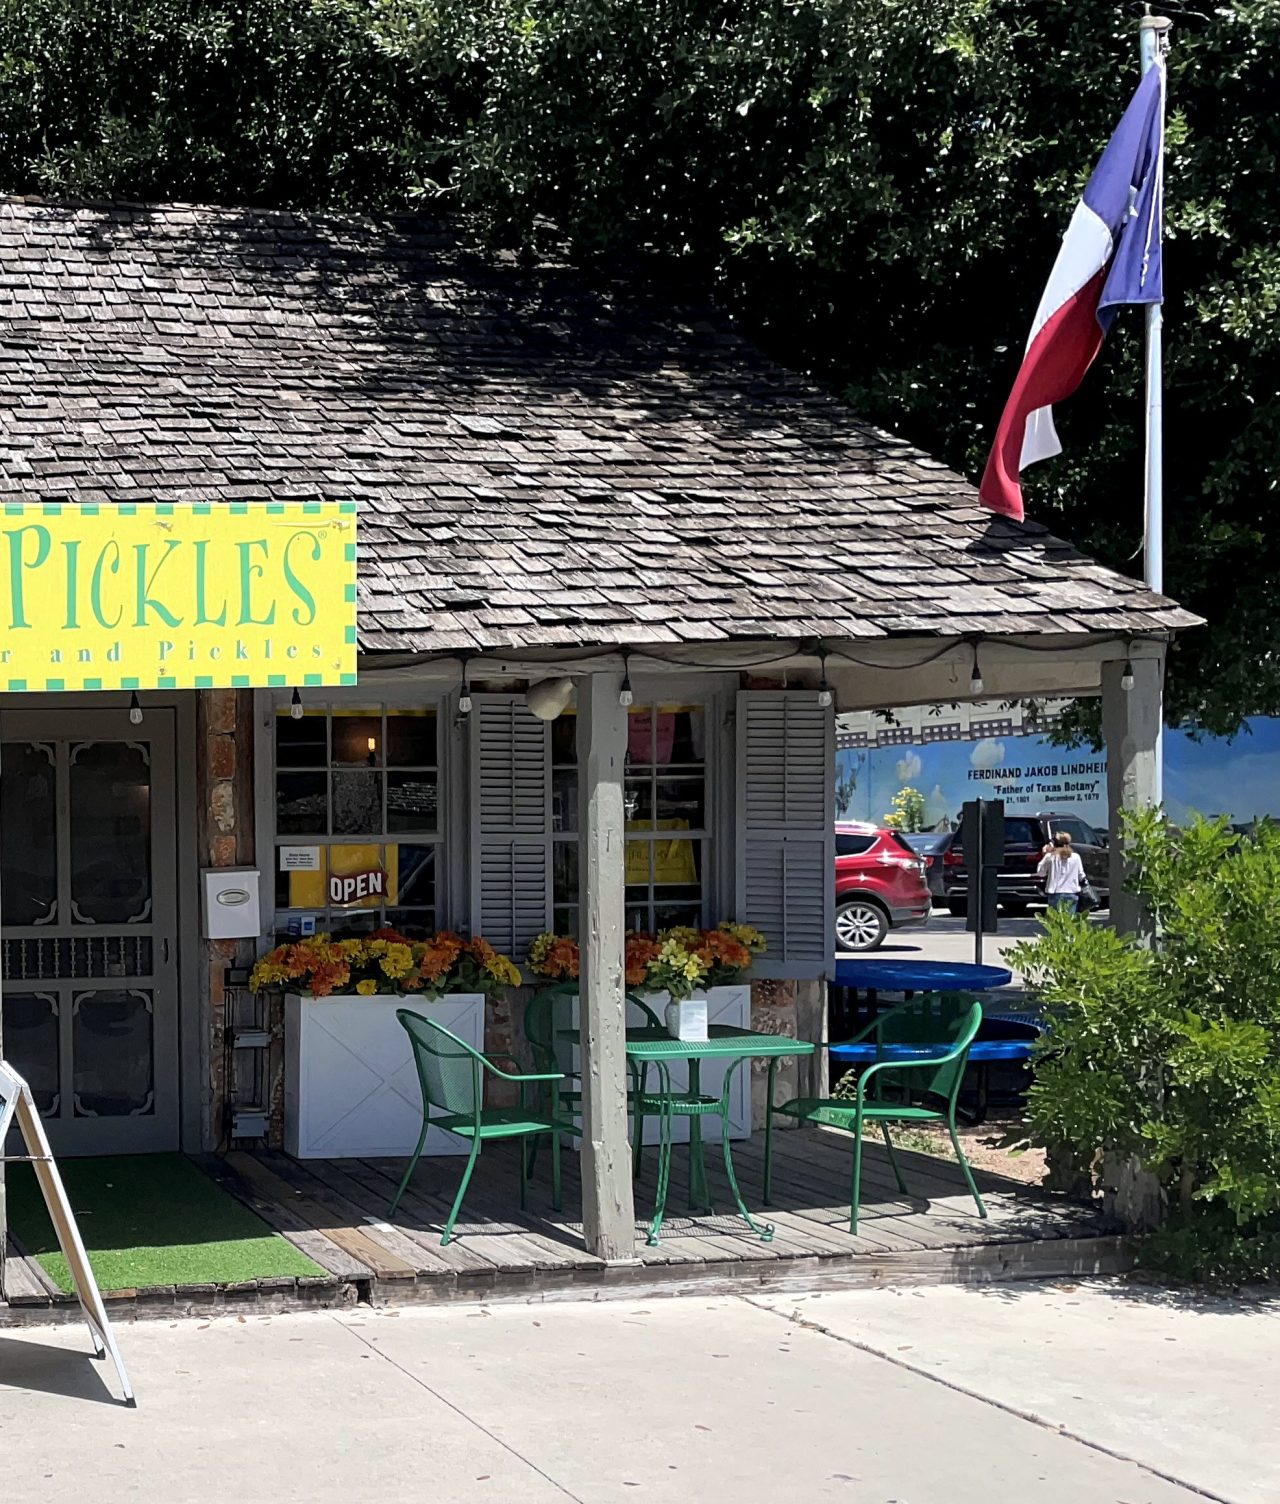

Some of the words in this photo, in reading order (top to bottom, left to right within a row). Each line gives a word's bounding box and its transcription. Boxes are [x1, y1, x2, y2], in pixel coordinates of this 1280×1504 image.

[2, 523, 322, 631] PICKLES
[49, 641, 121, 662] and
[158, 639, 323, 660] Pickles
[967, 768, 1022, 780] FERDINAND
[1024, 765, 1058, 778] JAKOB
[1061, 762, 1108, 776] LINDHEI
[993, 783, 1023, 795] "Father
[1025, 783, 1035, 793] of
[1036, 782, 1062, 793] Texas
[1064, 780, 1100, 793] Botany"
[330, 872, 382, 901] OPEN
